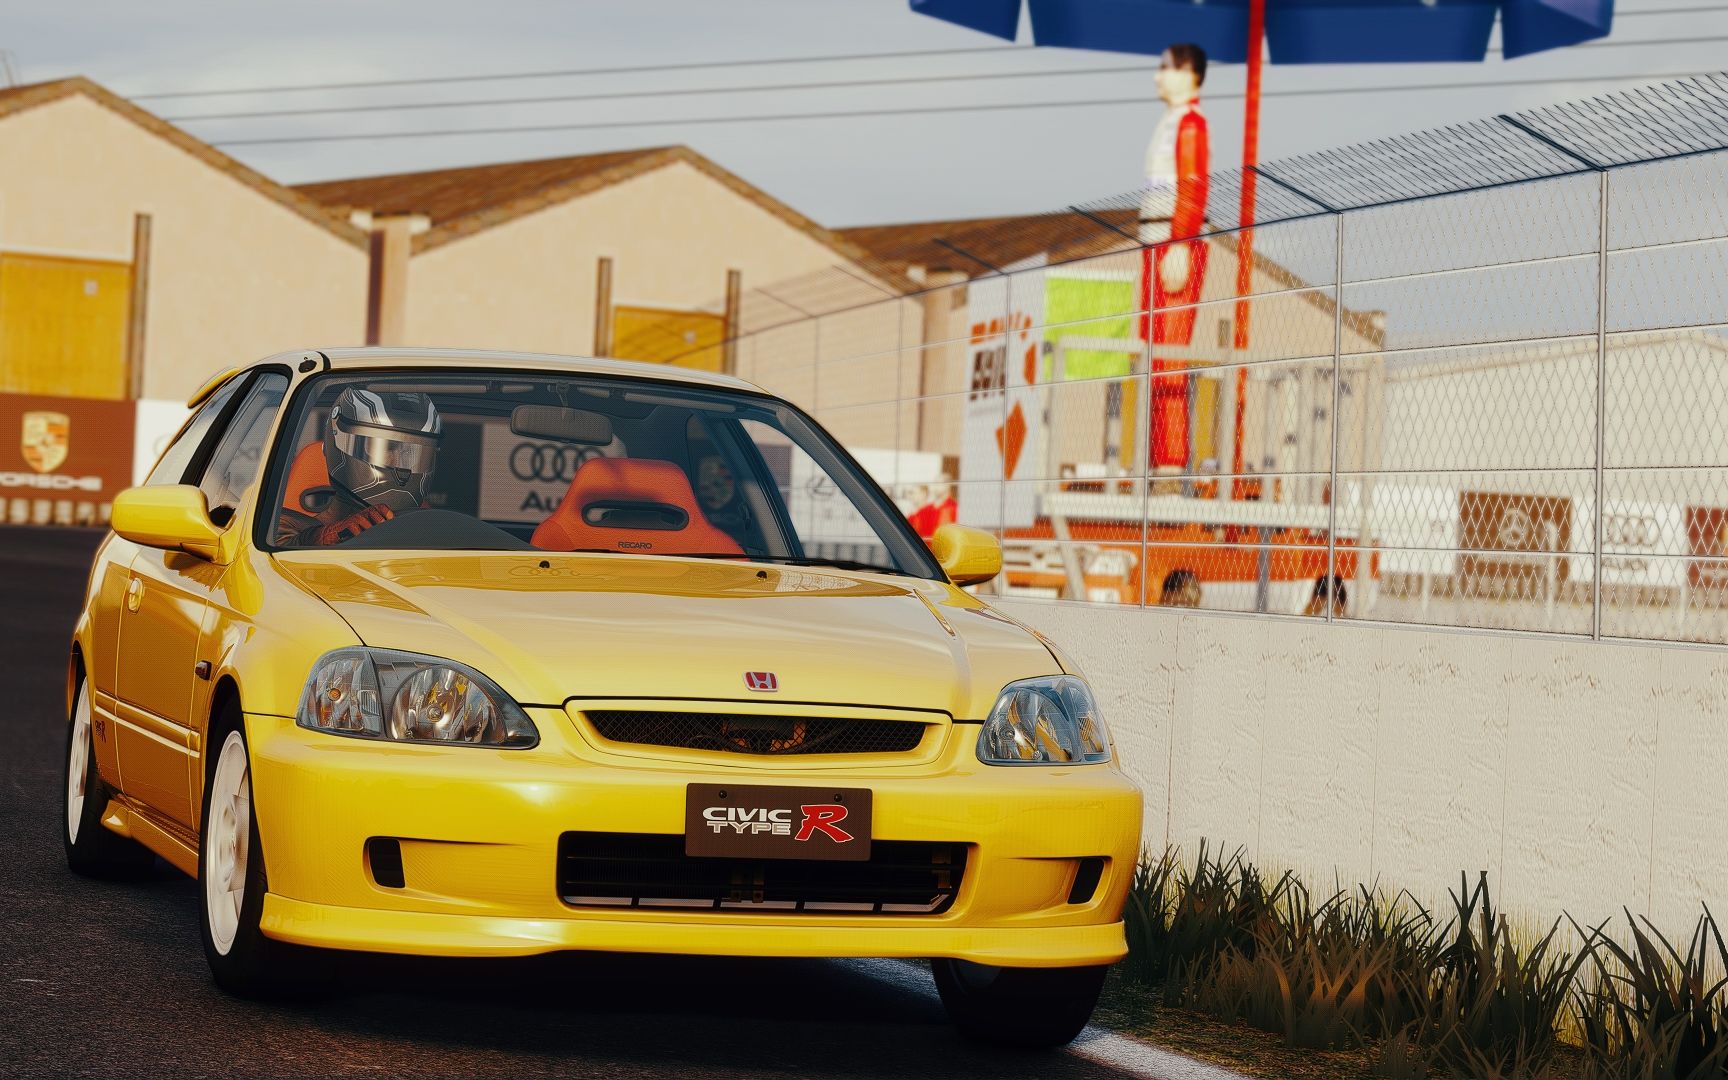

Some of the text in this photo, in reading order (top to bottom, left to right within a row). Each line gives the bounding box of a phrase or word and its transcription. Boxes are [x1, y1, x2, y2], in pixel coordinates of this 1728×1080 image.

[0, 472, 103, 491] ORSCHE
[618, 541, 652, 550] RECARO
[702, 806, 792, 823] CIVIC
[706, 804, 855, 843] TYPE R
